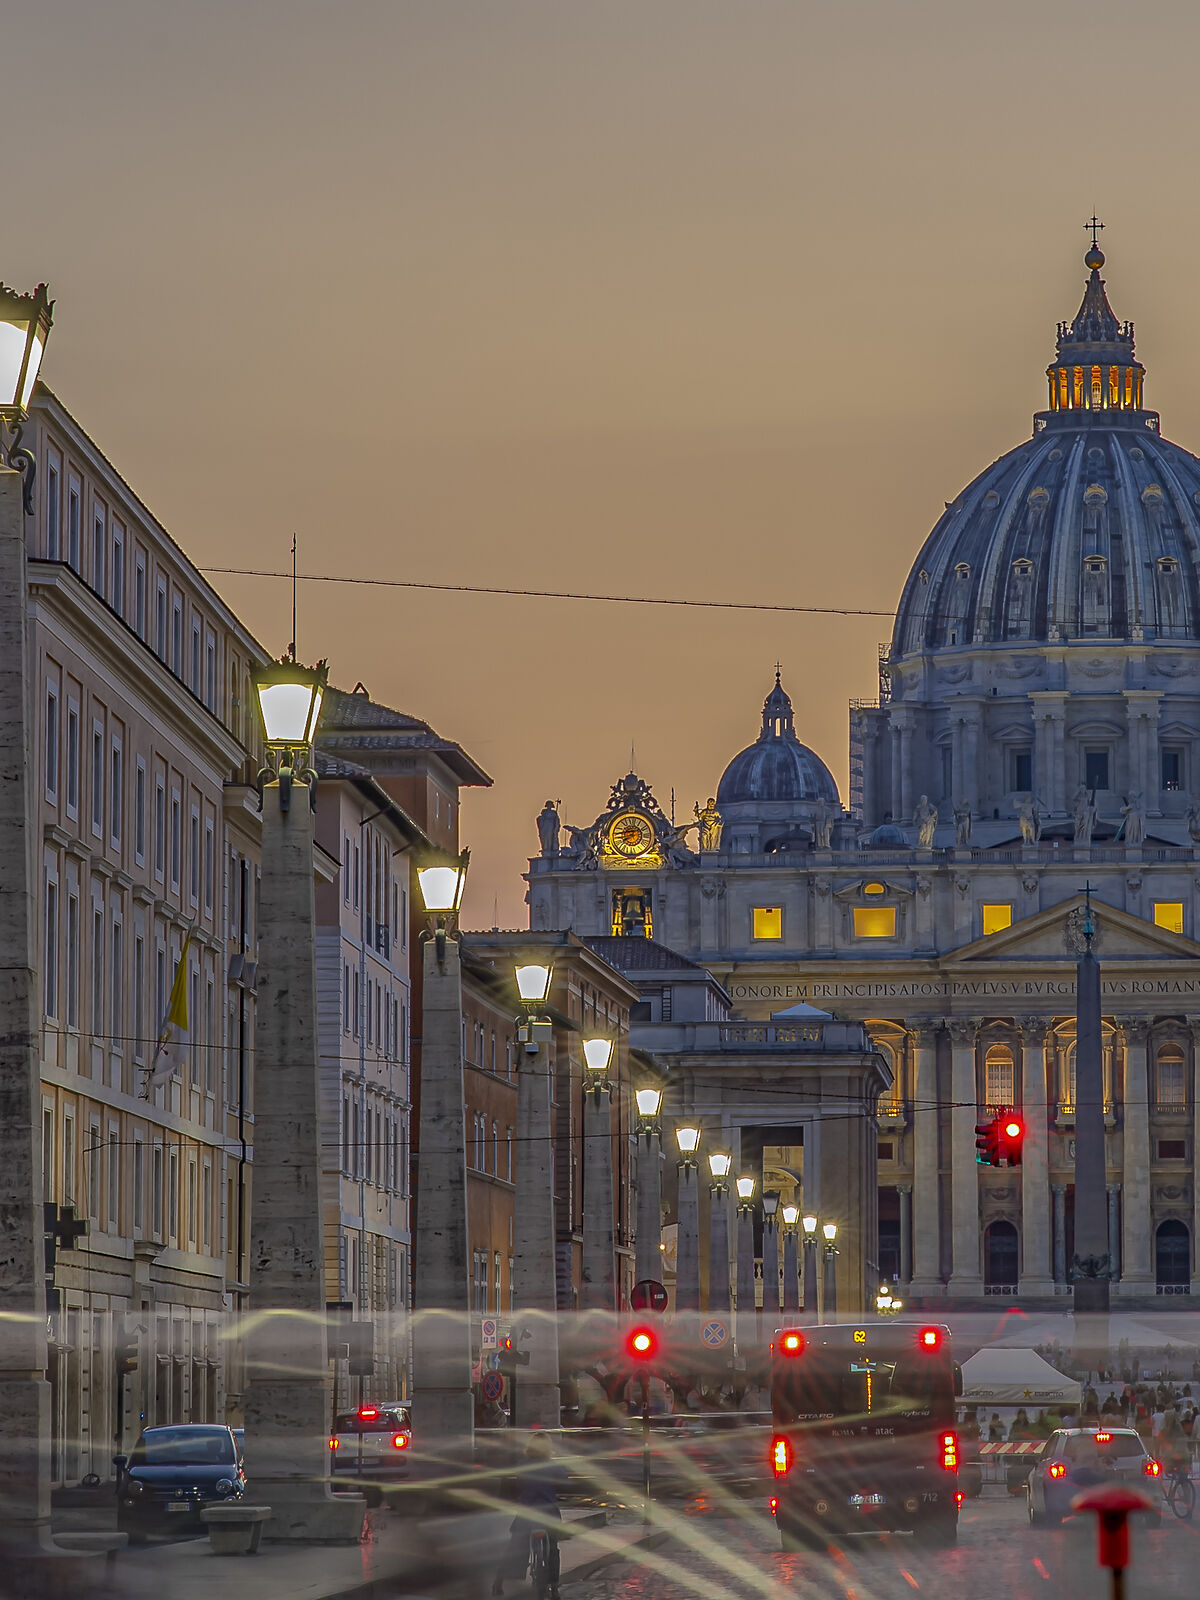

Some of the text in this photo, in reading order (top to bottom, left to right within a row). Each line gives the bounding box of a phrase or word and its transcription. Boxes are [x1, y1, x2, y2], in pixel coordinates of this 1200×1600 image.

[813, 983, 895, 997] PRINCIPIS
[899, 983, 950, 996] APOST
[953, 982, 1008, 995] PAVLVS
[1010, 982, 1020, 994] V
[853, 1330, 866, 1343] 62
[901, 1410, 930, 1418] hybrid
[875, 1427, 894, 1436] atac
[922, 1493, 938, 1502] 712
